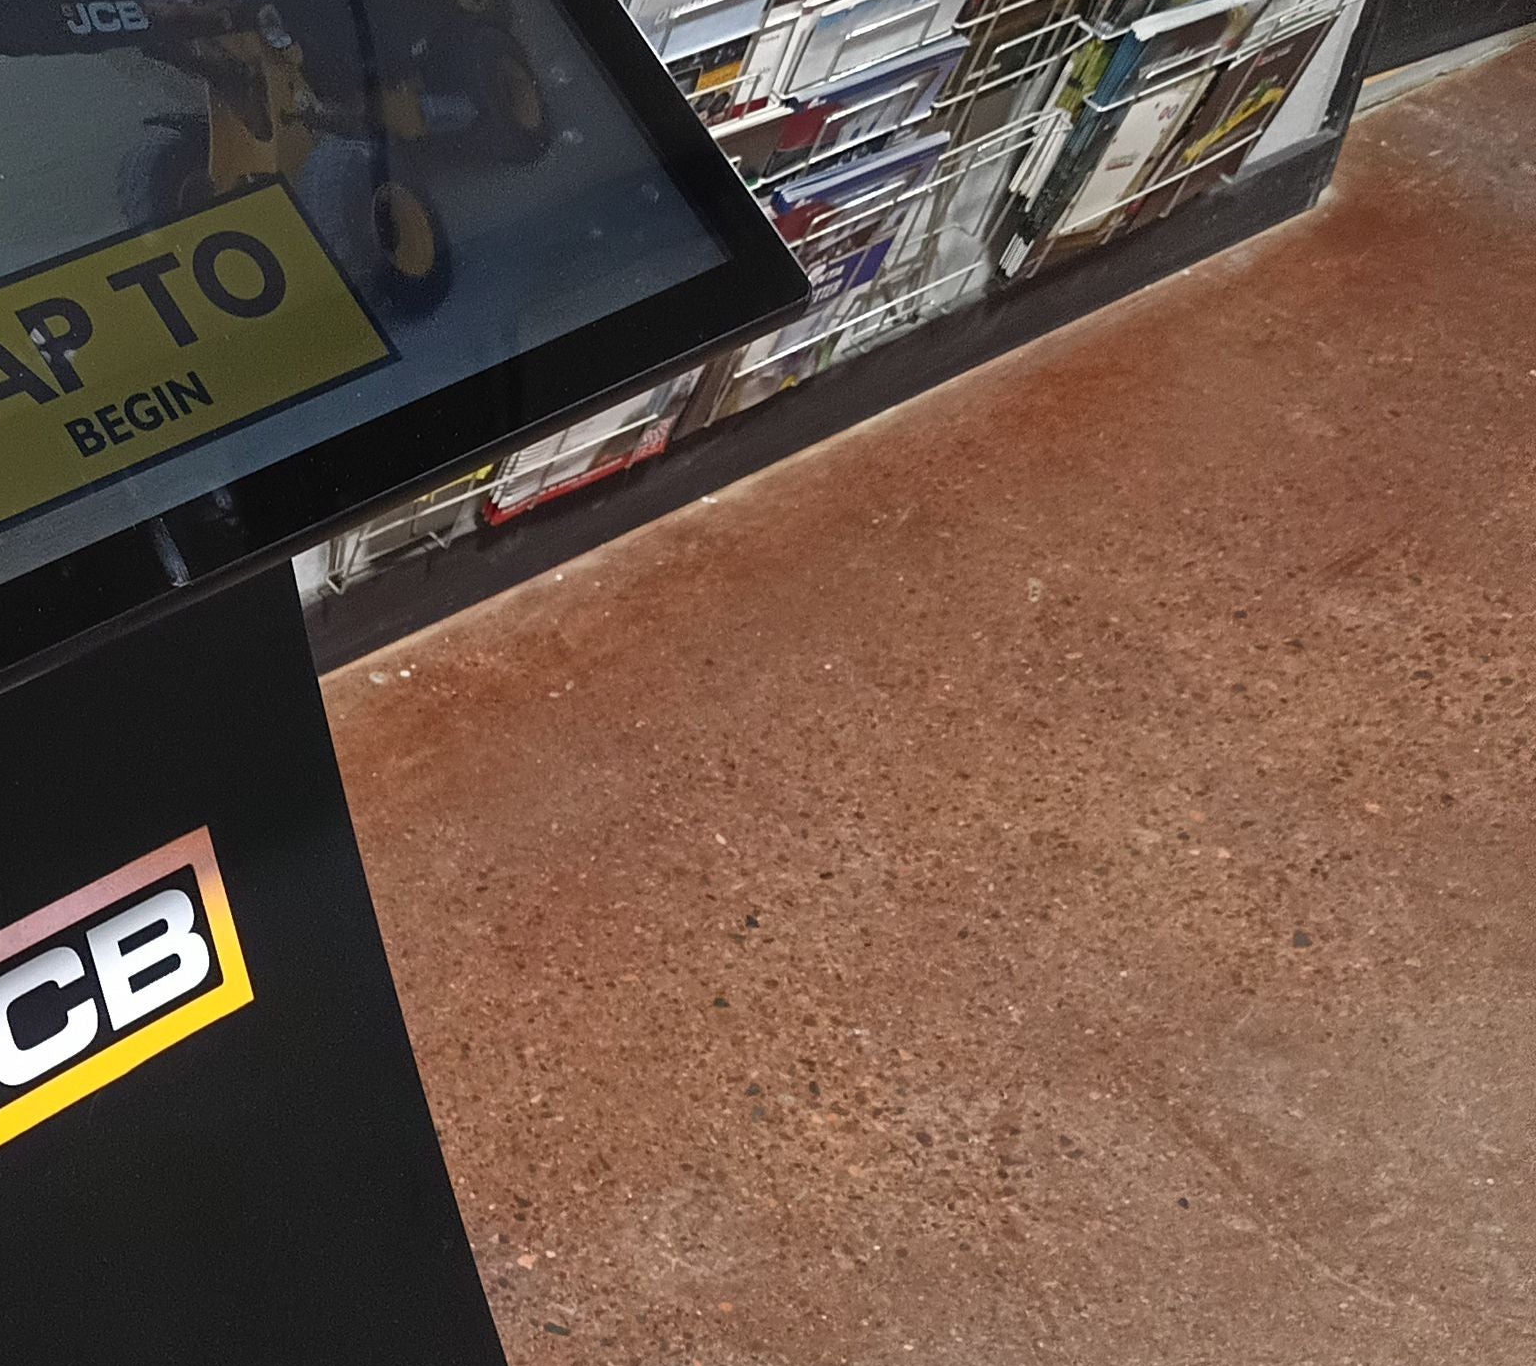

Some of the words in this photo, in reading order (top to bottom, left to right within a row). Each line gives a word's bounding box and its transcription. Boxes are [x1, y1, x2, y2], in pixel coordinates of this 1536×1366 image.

[66, 0, 149, 36] JCB
[107, 229, 287, 349] TO
[64, 370, 214, 458] BEGIN
